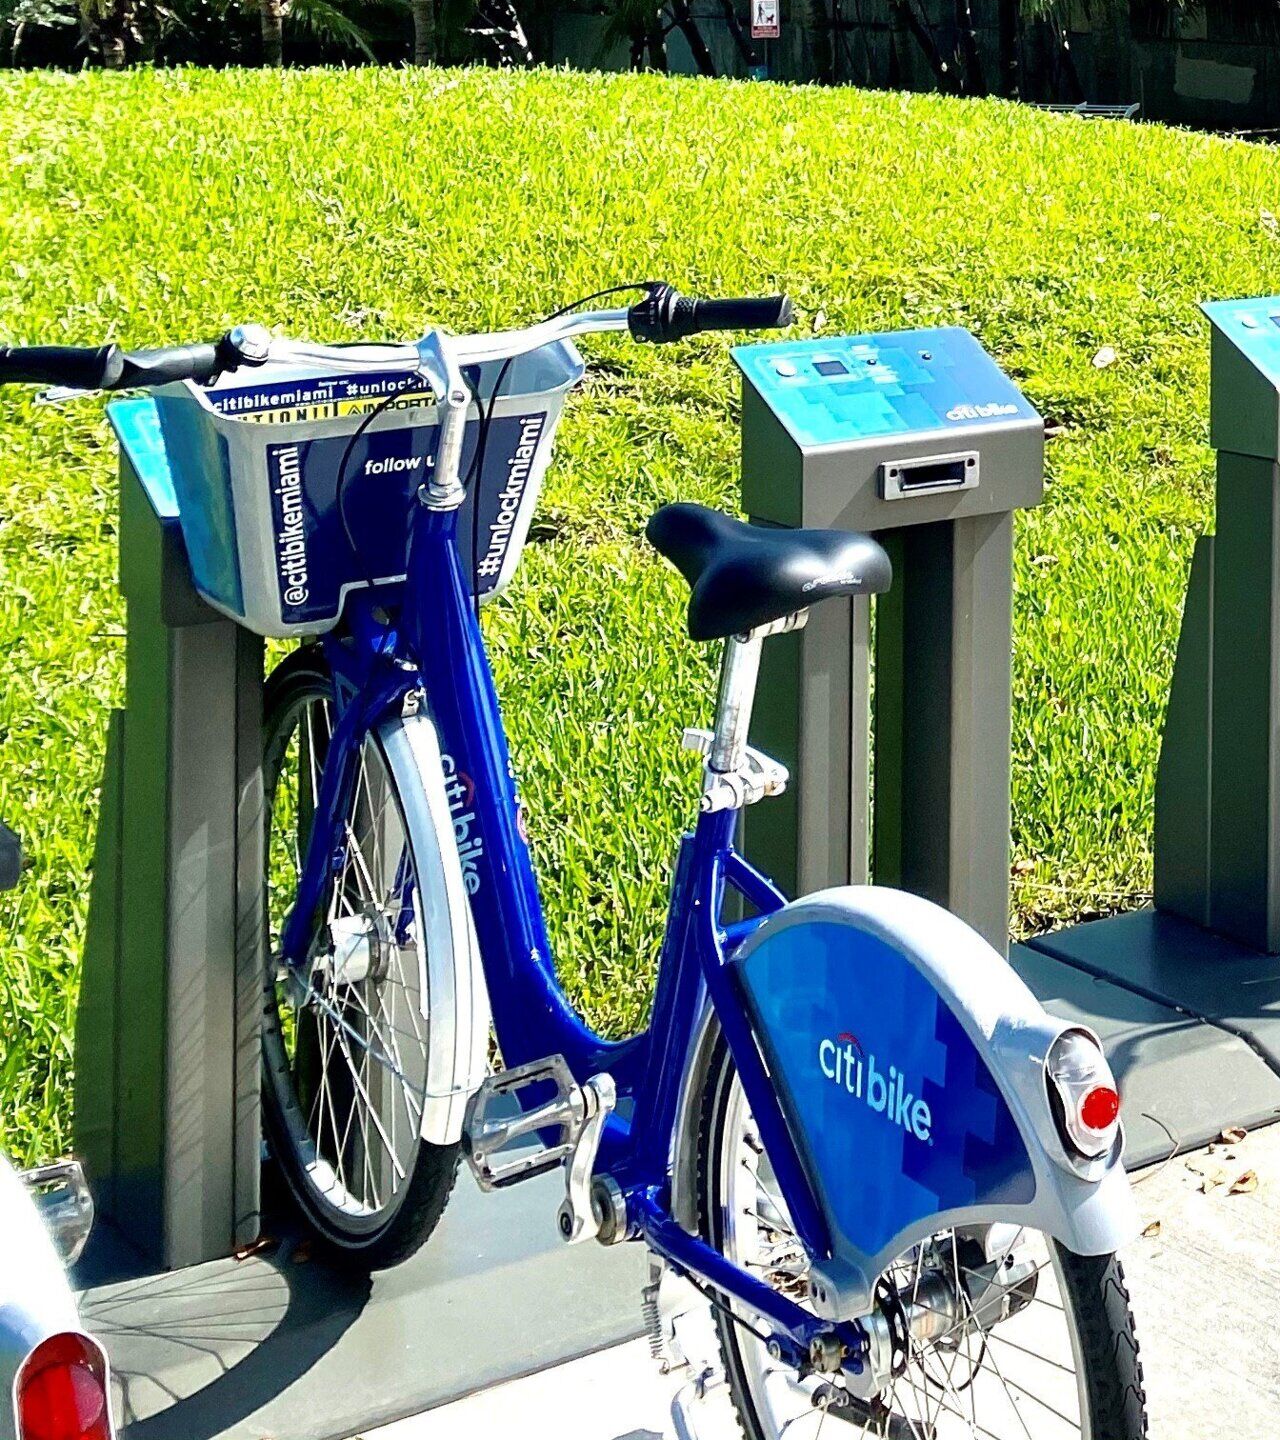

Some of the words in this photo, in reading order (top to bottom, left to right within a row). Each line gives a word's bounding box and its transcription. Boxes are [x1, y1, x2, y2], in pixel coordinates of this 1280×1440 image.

[364, 456, 422, 476] follow
[477, 417, 543, 578] #unlockmiami
[271, 446, 309, 606] @citibikemiami
[440, 753, 467, 812] citi
[452, 811, 484, 896] bike
[819, 1037, 863, 1099] citi
[866, 1053, 932, 1141] bike
